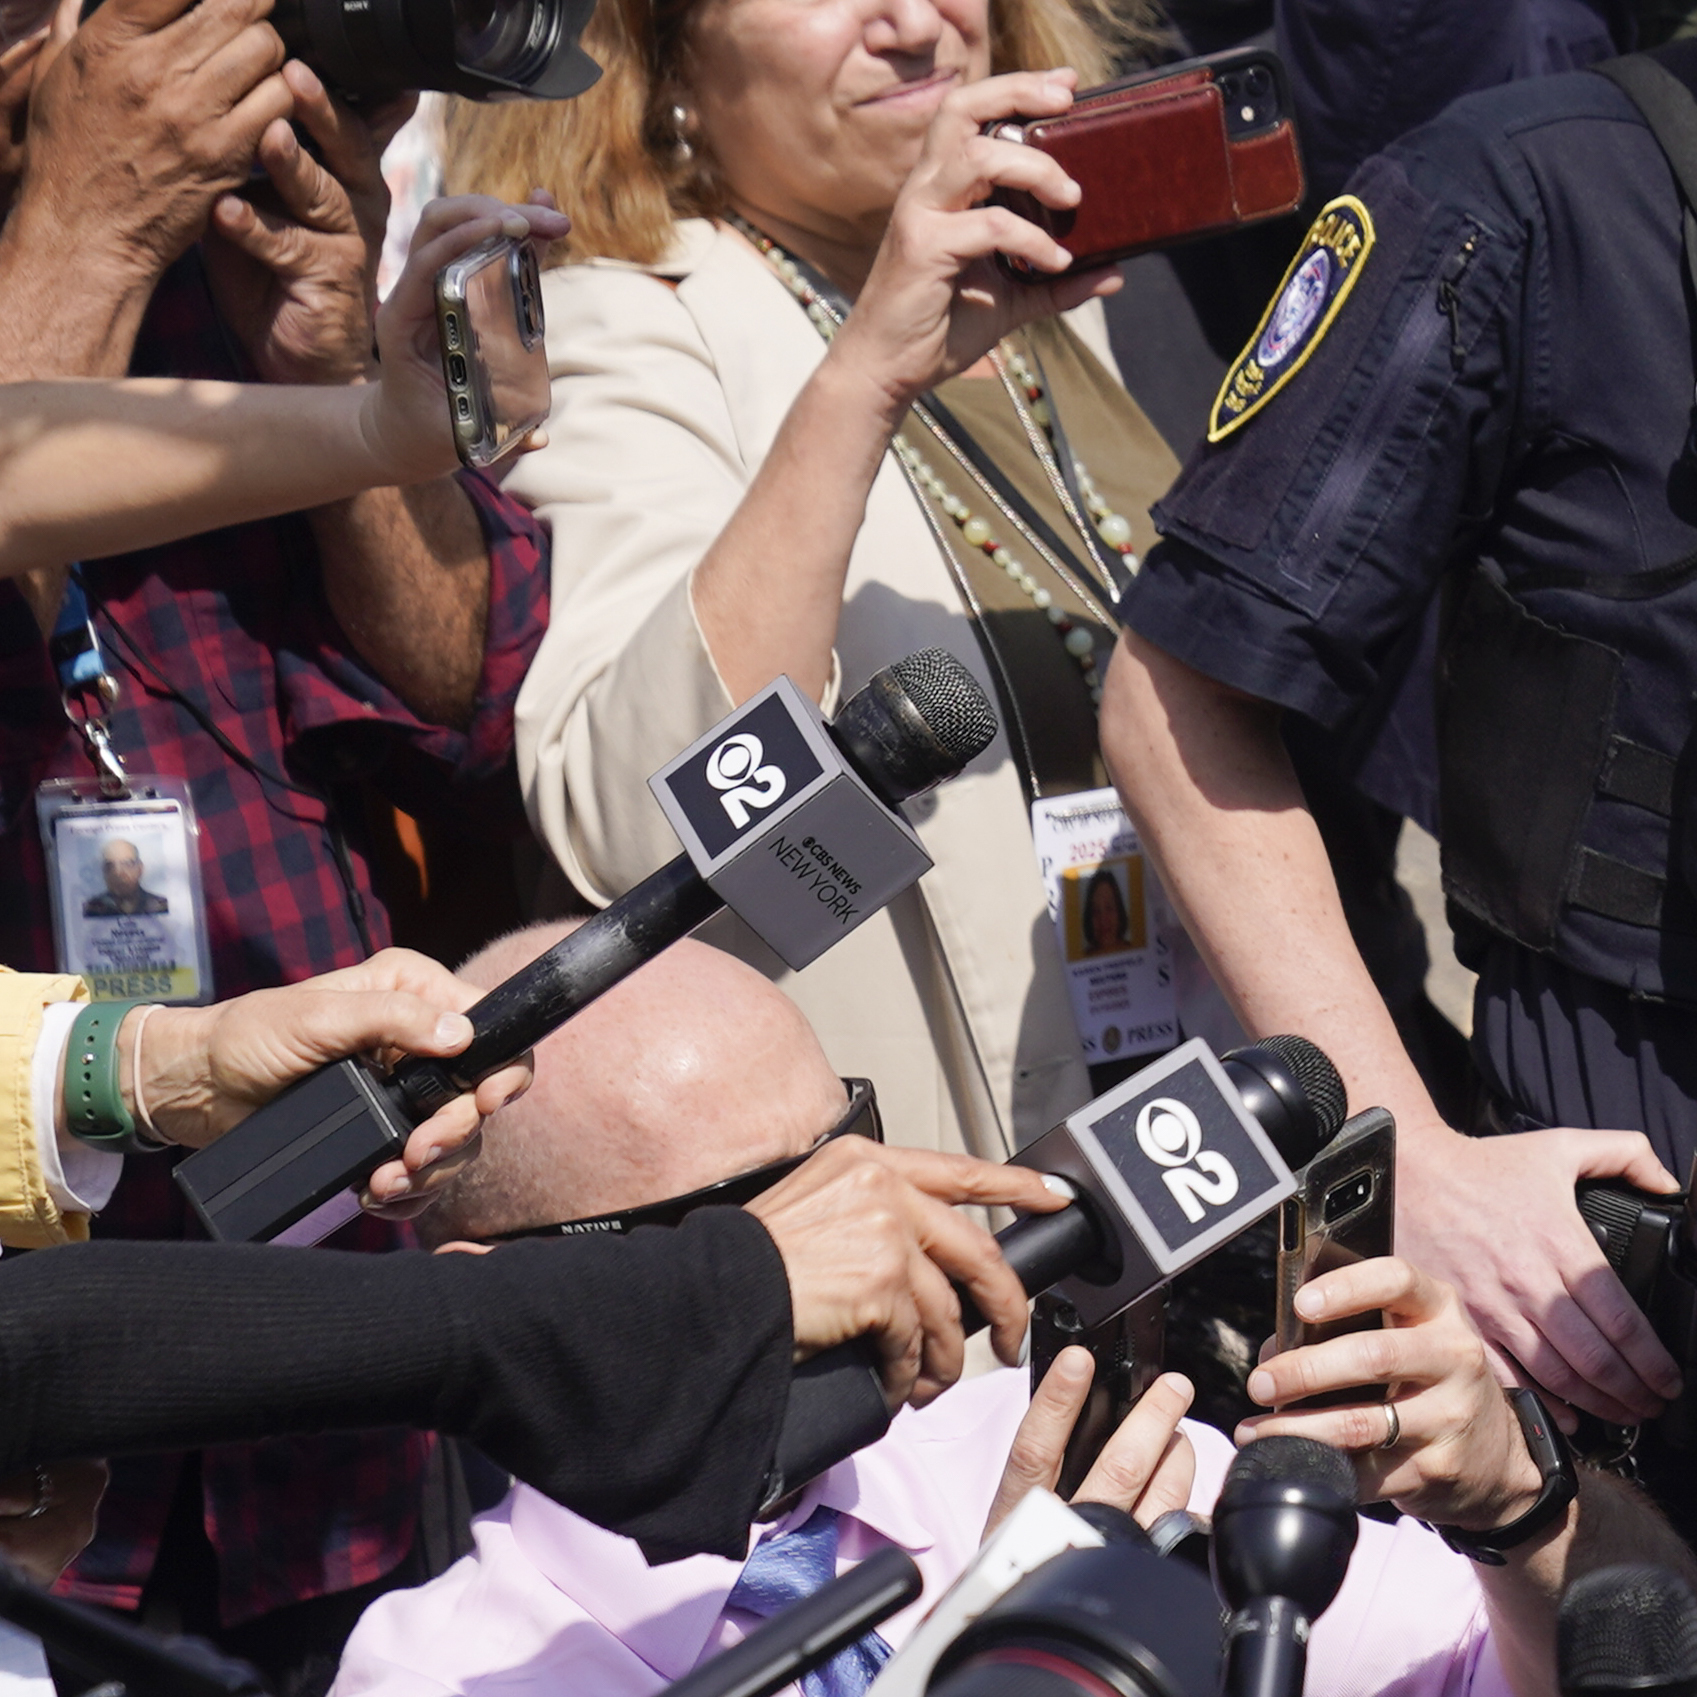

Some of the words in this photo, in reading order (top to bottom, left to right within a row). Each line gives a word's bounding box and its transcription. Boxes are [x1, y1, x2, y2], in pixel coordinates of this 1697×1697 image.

[768, 835, 818, 880] NEW
[808, 872, 861, 925] YORK
[810, 844, 834, 867] CBS
[827, 861, 862, 895] NEWS
[93, 973, 173, 998] PRESS
